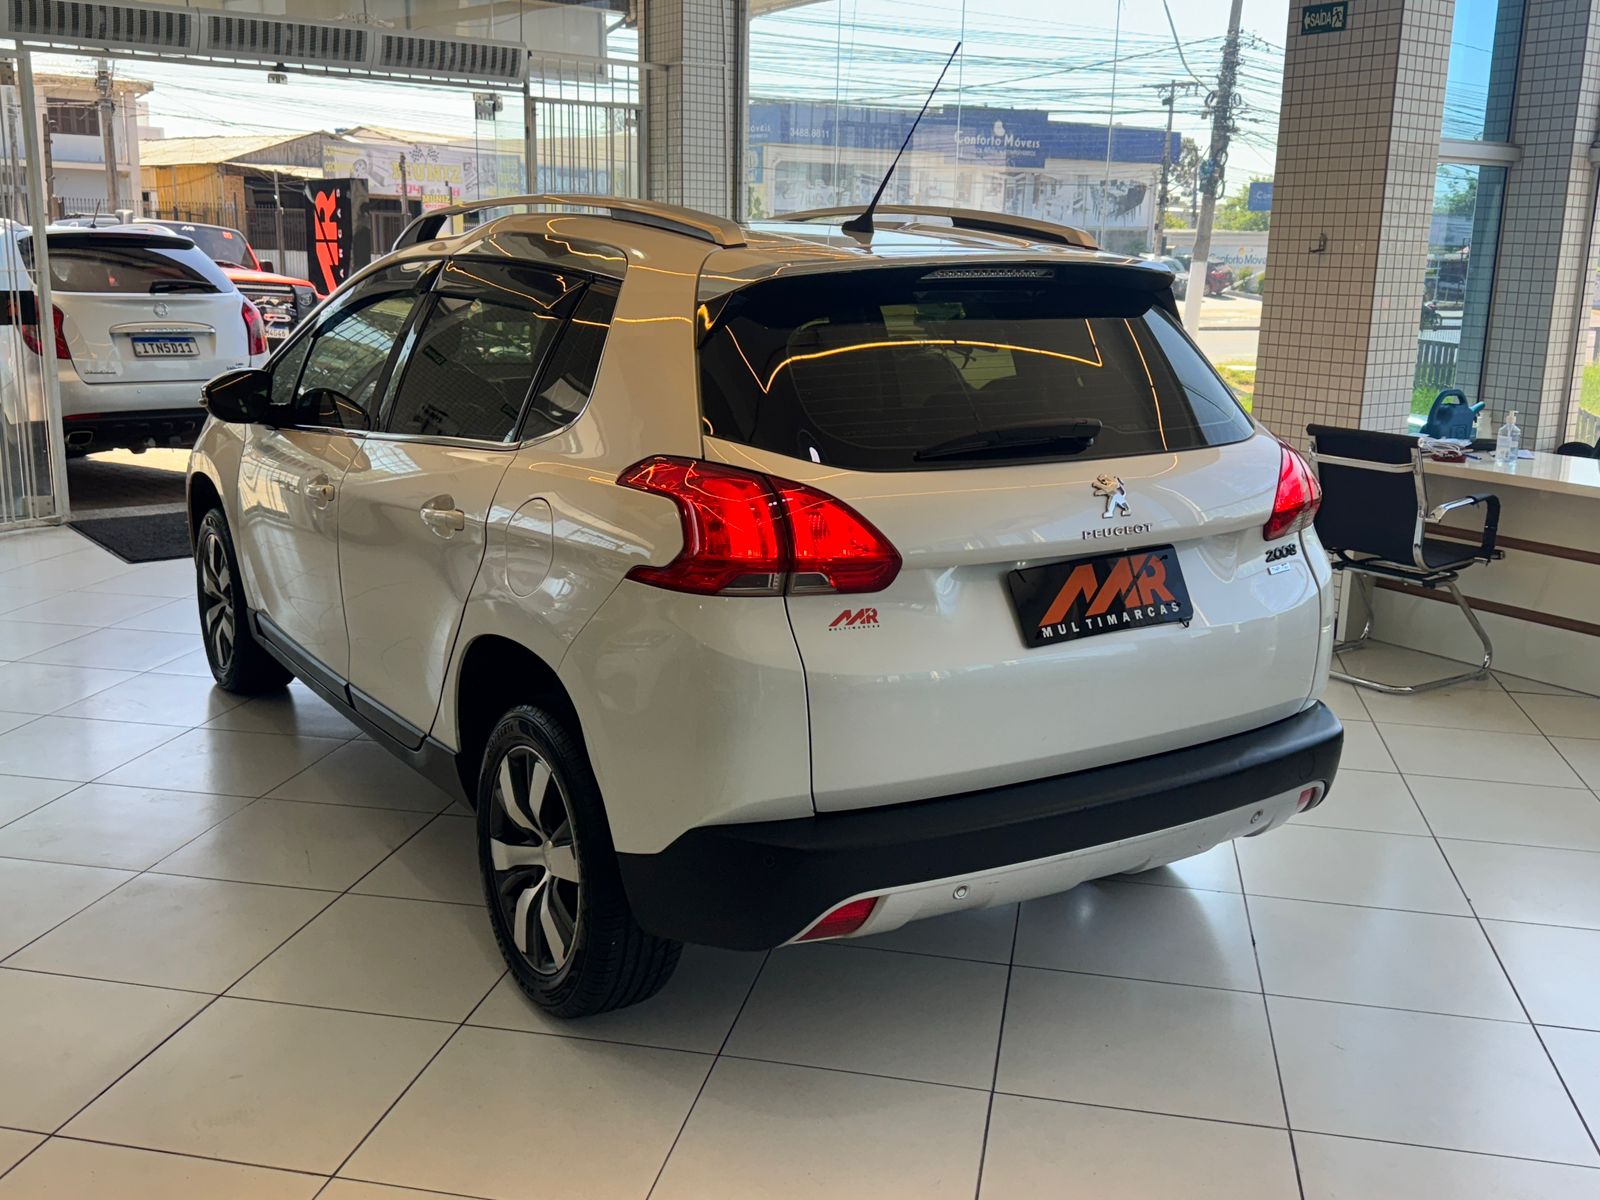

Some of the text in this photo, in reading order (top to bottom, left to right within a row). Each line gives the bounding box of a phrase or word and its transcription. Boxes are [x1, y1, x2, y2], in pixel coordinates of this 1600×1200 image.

[1310, 9, 1331, 27] SAÍDA
[954, 131, 1040, 148] Conforto Móveis
[142, 343, 194, 354] ITN5D11
[1082, 523, 1152, 540] PEUGEOT
[1265, 543, 1297, 563] 2008
[1042, 602, 1180, 638] MULTIMARCAS
